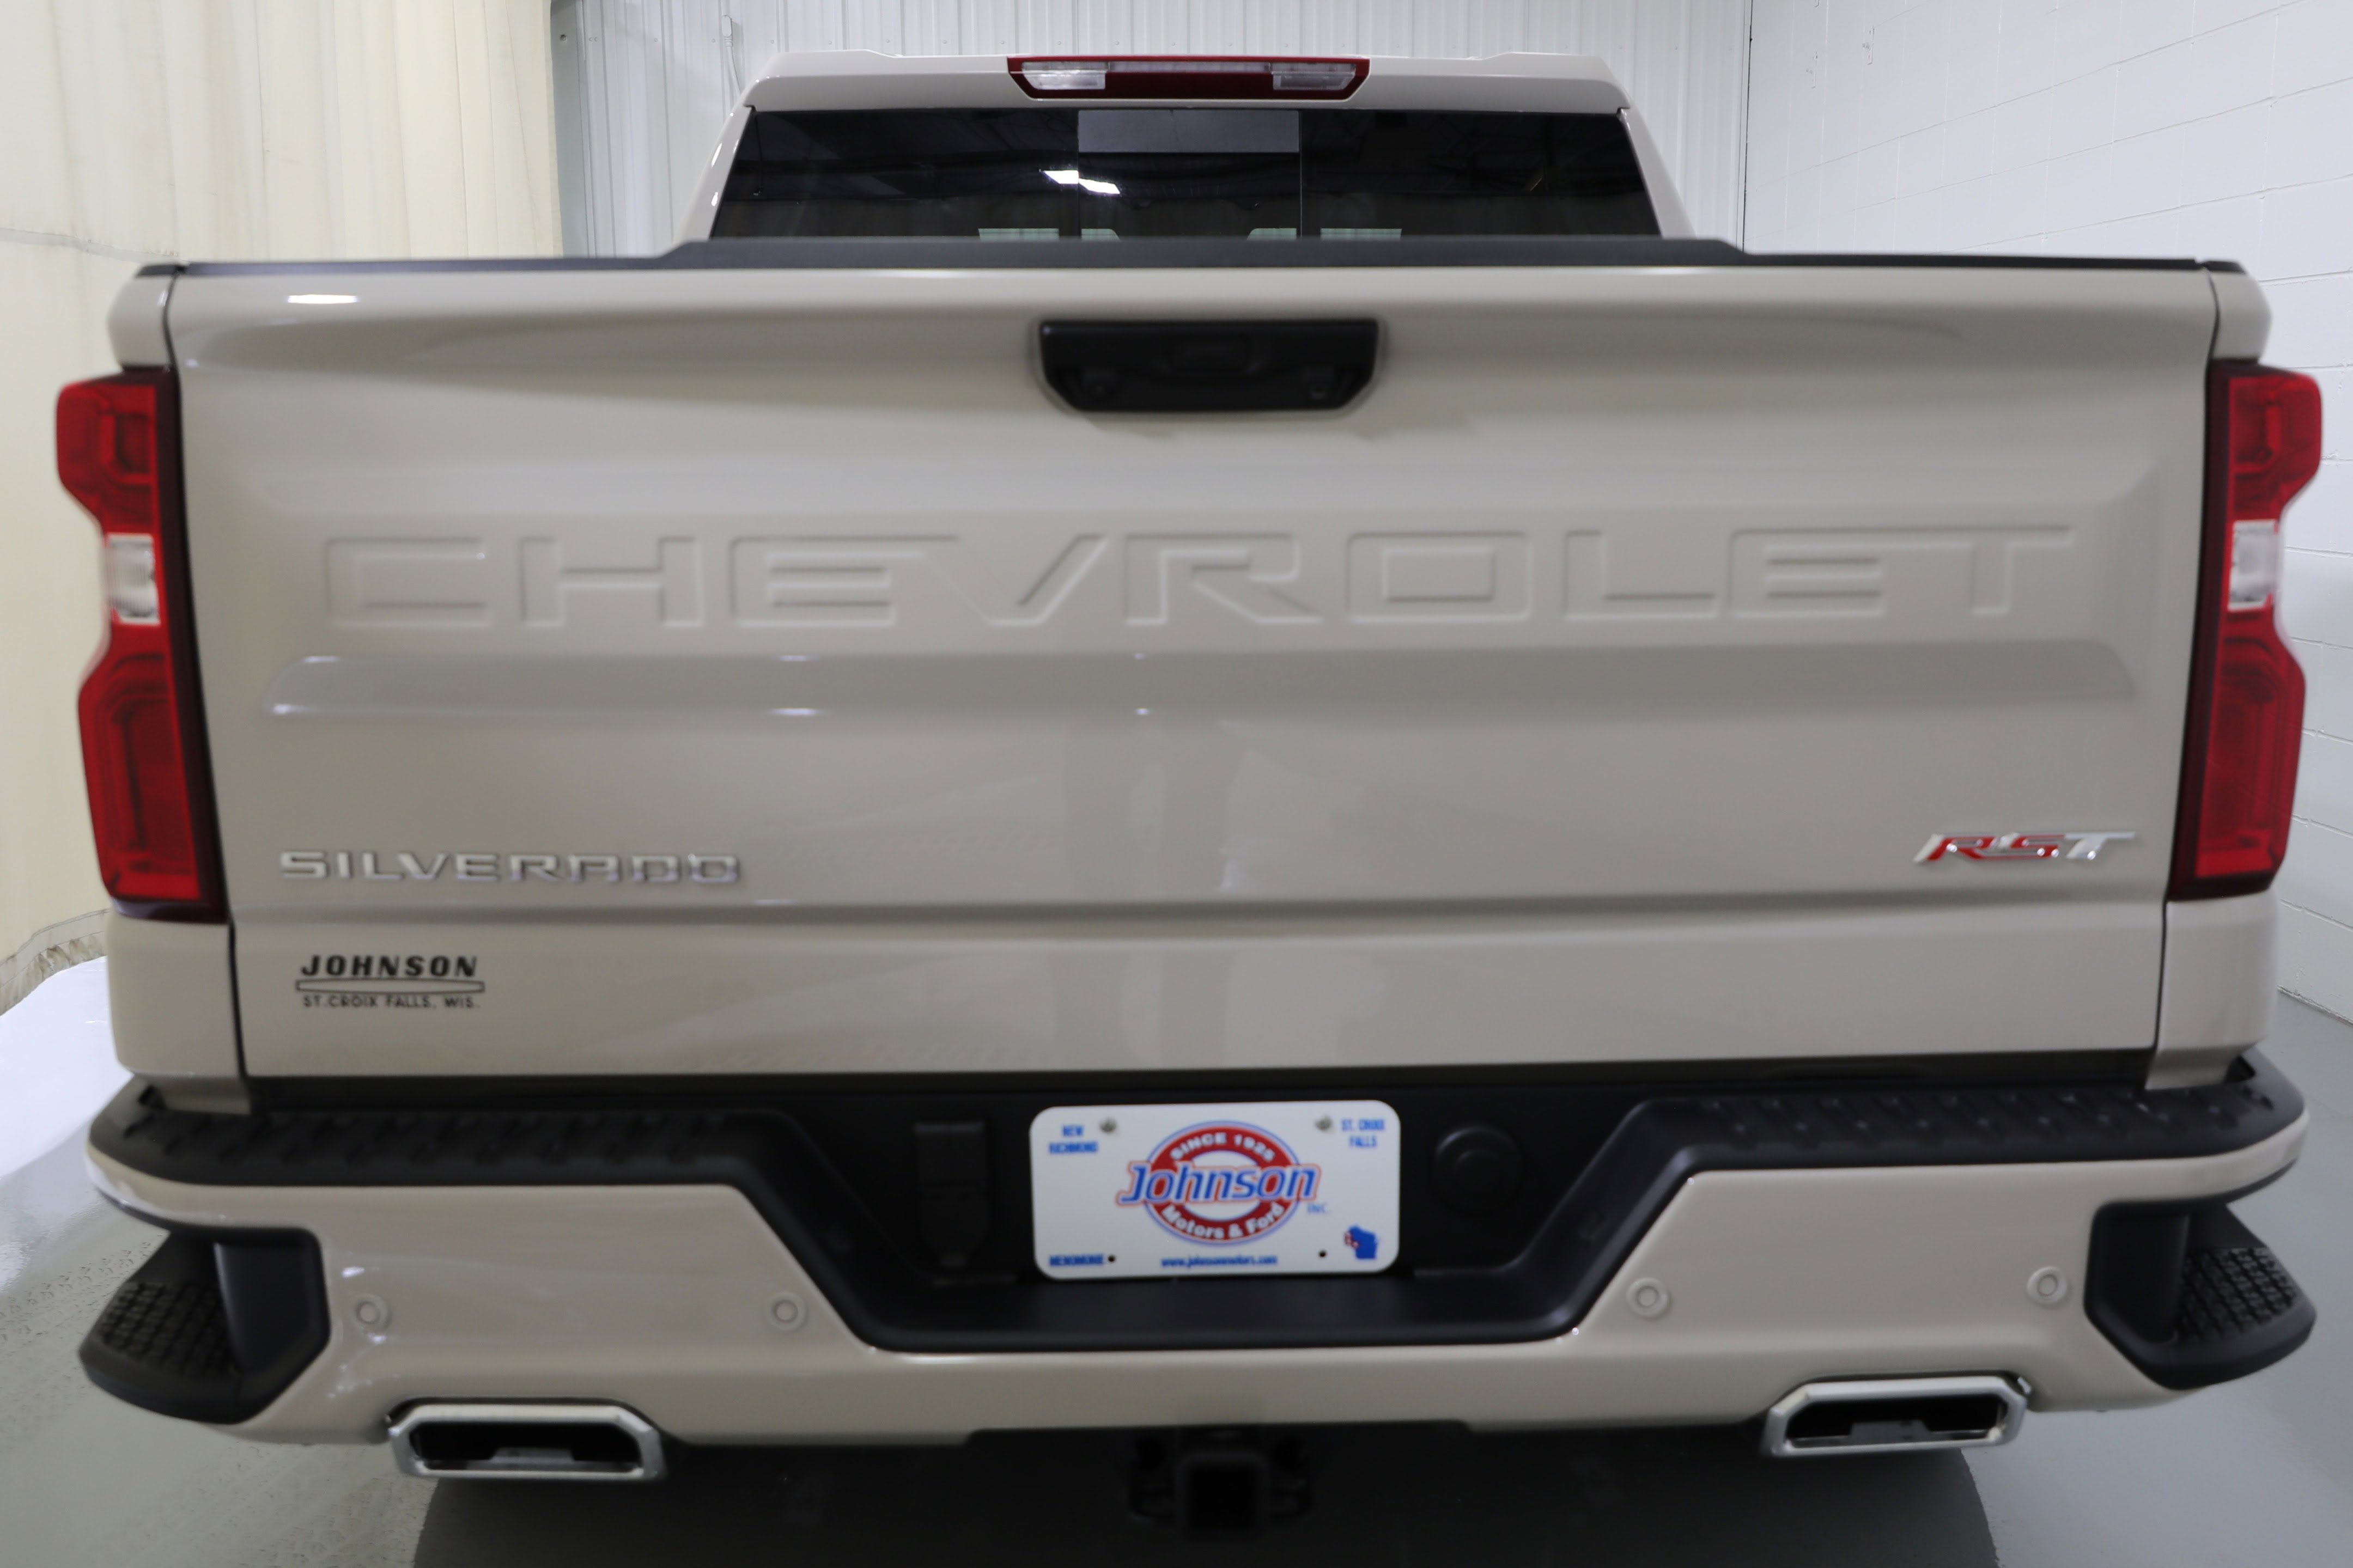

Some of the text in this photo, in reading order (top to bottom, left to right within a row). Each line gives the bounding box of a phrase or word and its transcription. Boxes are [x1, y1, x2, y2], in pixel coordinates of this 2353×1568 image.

[325, 526, 2076, 629] CHEVROLET
[1912, 831, 2137, 863] RST
[279, 851, 741, 882] SILVERADO
[301, 955, 477, 977] JOHNSON
[1062, 1125, 1084, 1137] NEW
[1170, 1132, 1226, 1161] SINCE
[1349, 1136, 1377, 1148] FALLS
[1117, 1163, 1321, 1205] Johnson
[1160, 1197, 1286, 1240] Motors & Ford
